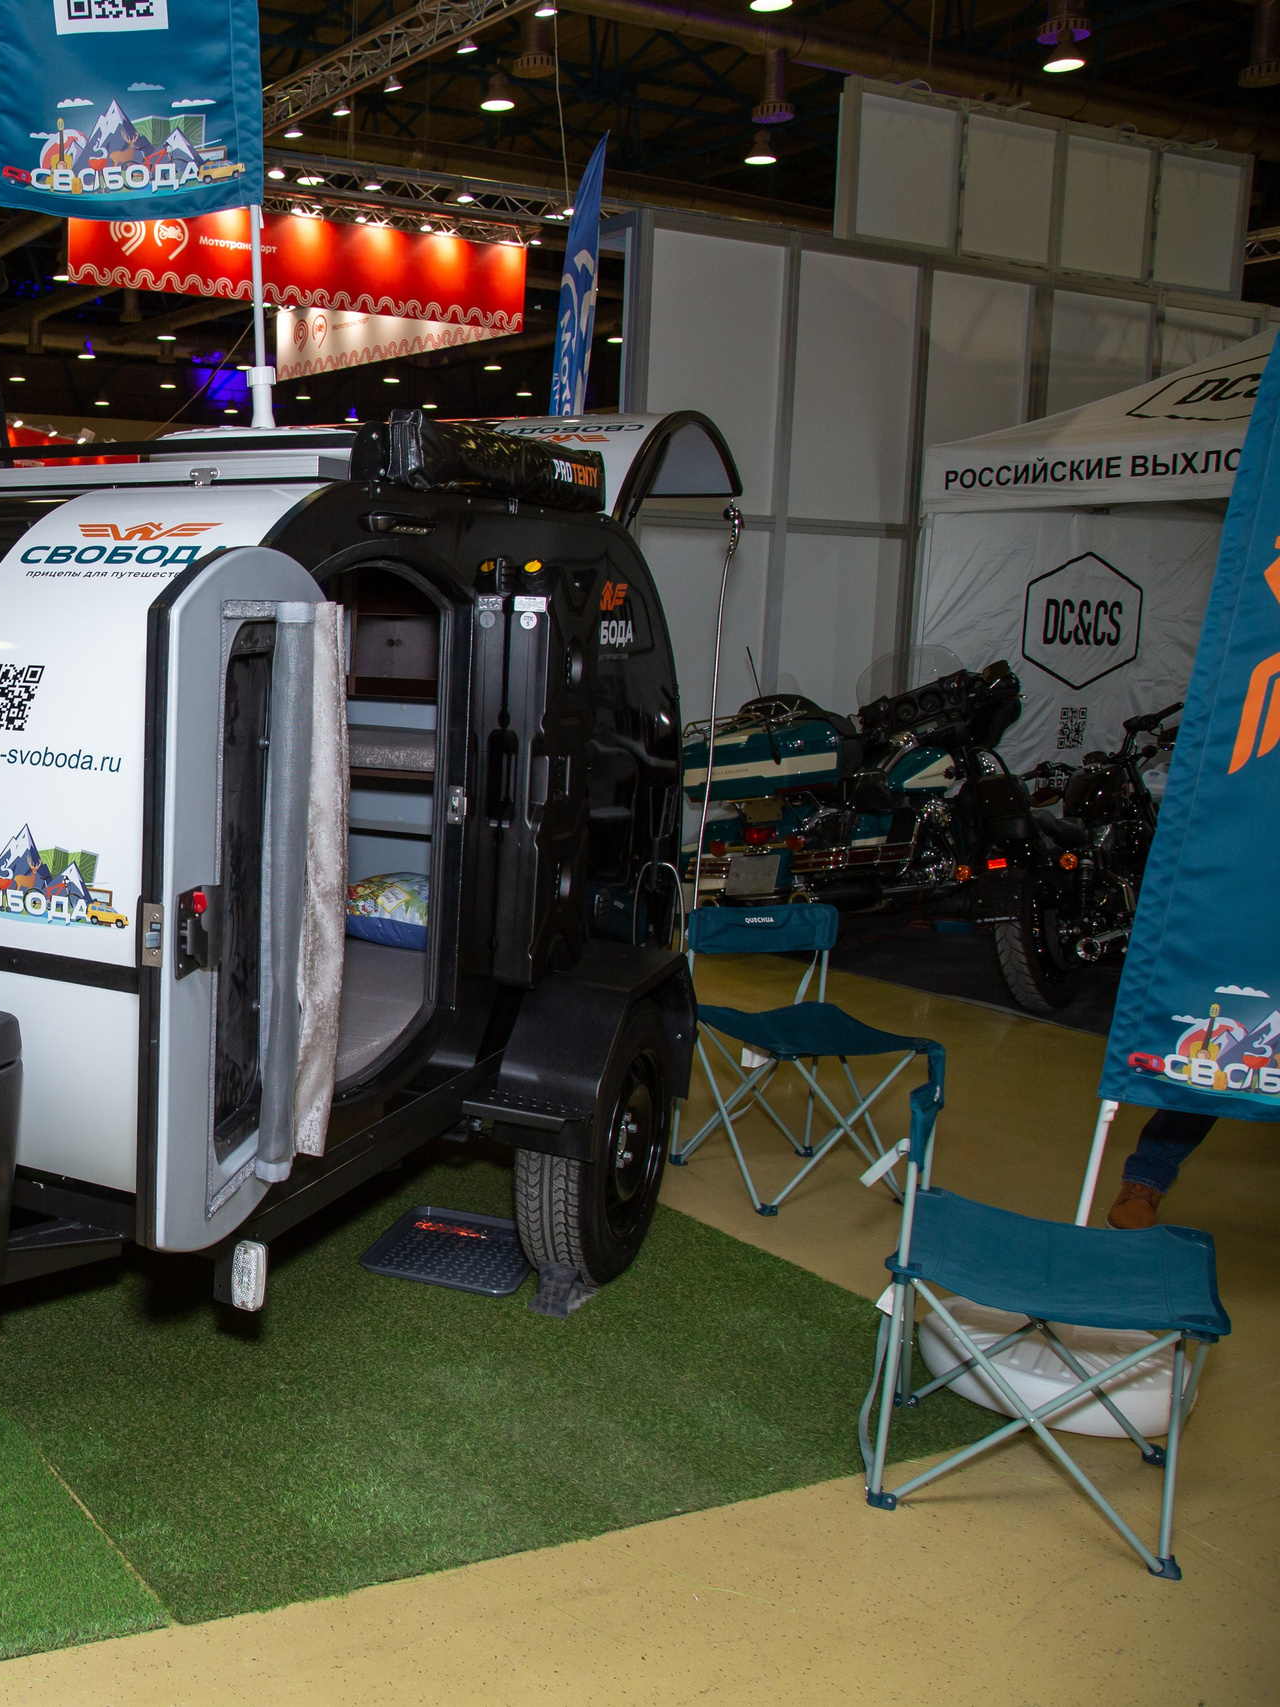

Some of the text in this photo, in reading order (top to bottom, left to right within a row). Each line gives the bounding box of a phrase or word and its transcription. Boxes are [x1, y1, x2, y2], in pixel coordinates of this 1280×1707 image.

[30, 161, 203, 193] СВОБОДА
[943, 456, 1123, 490] РОССИЙСКИЕ
[19, 545, 227, 568] СВОБОД
[25, 570, 81, 578] прицепы
[1042, 598, 1123, 647] DC&CS
[744, 916, 775, 924] QUECHUA
